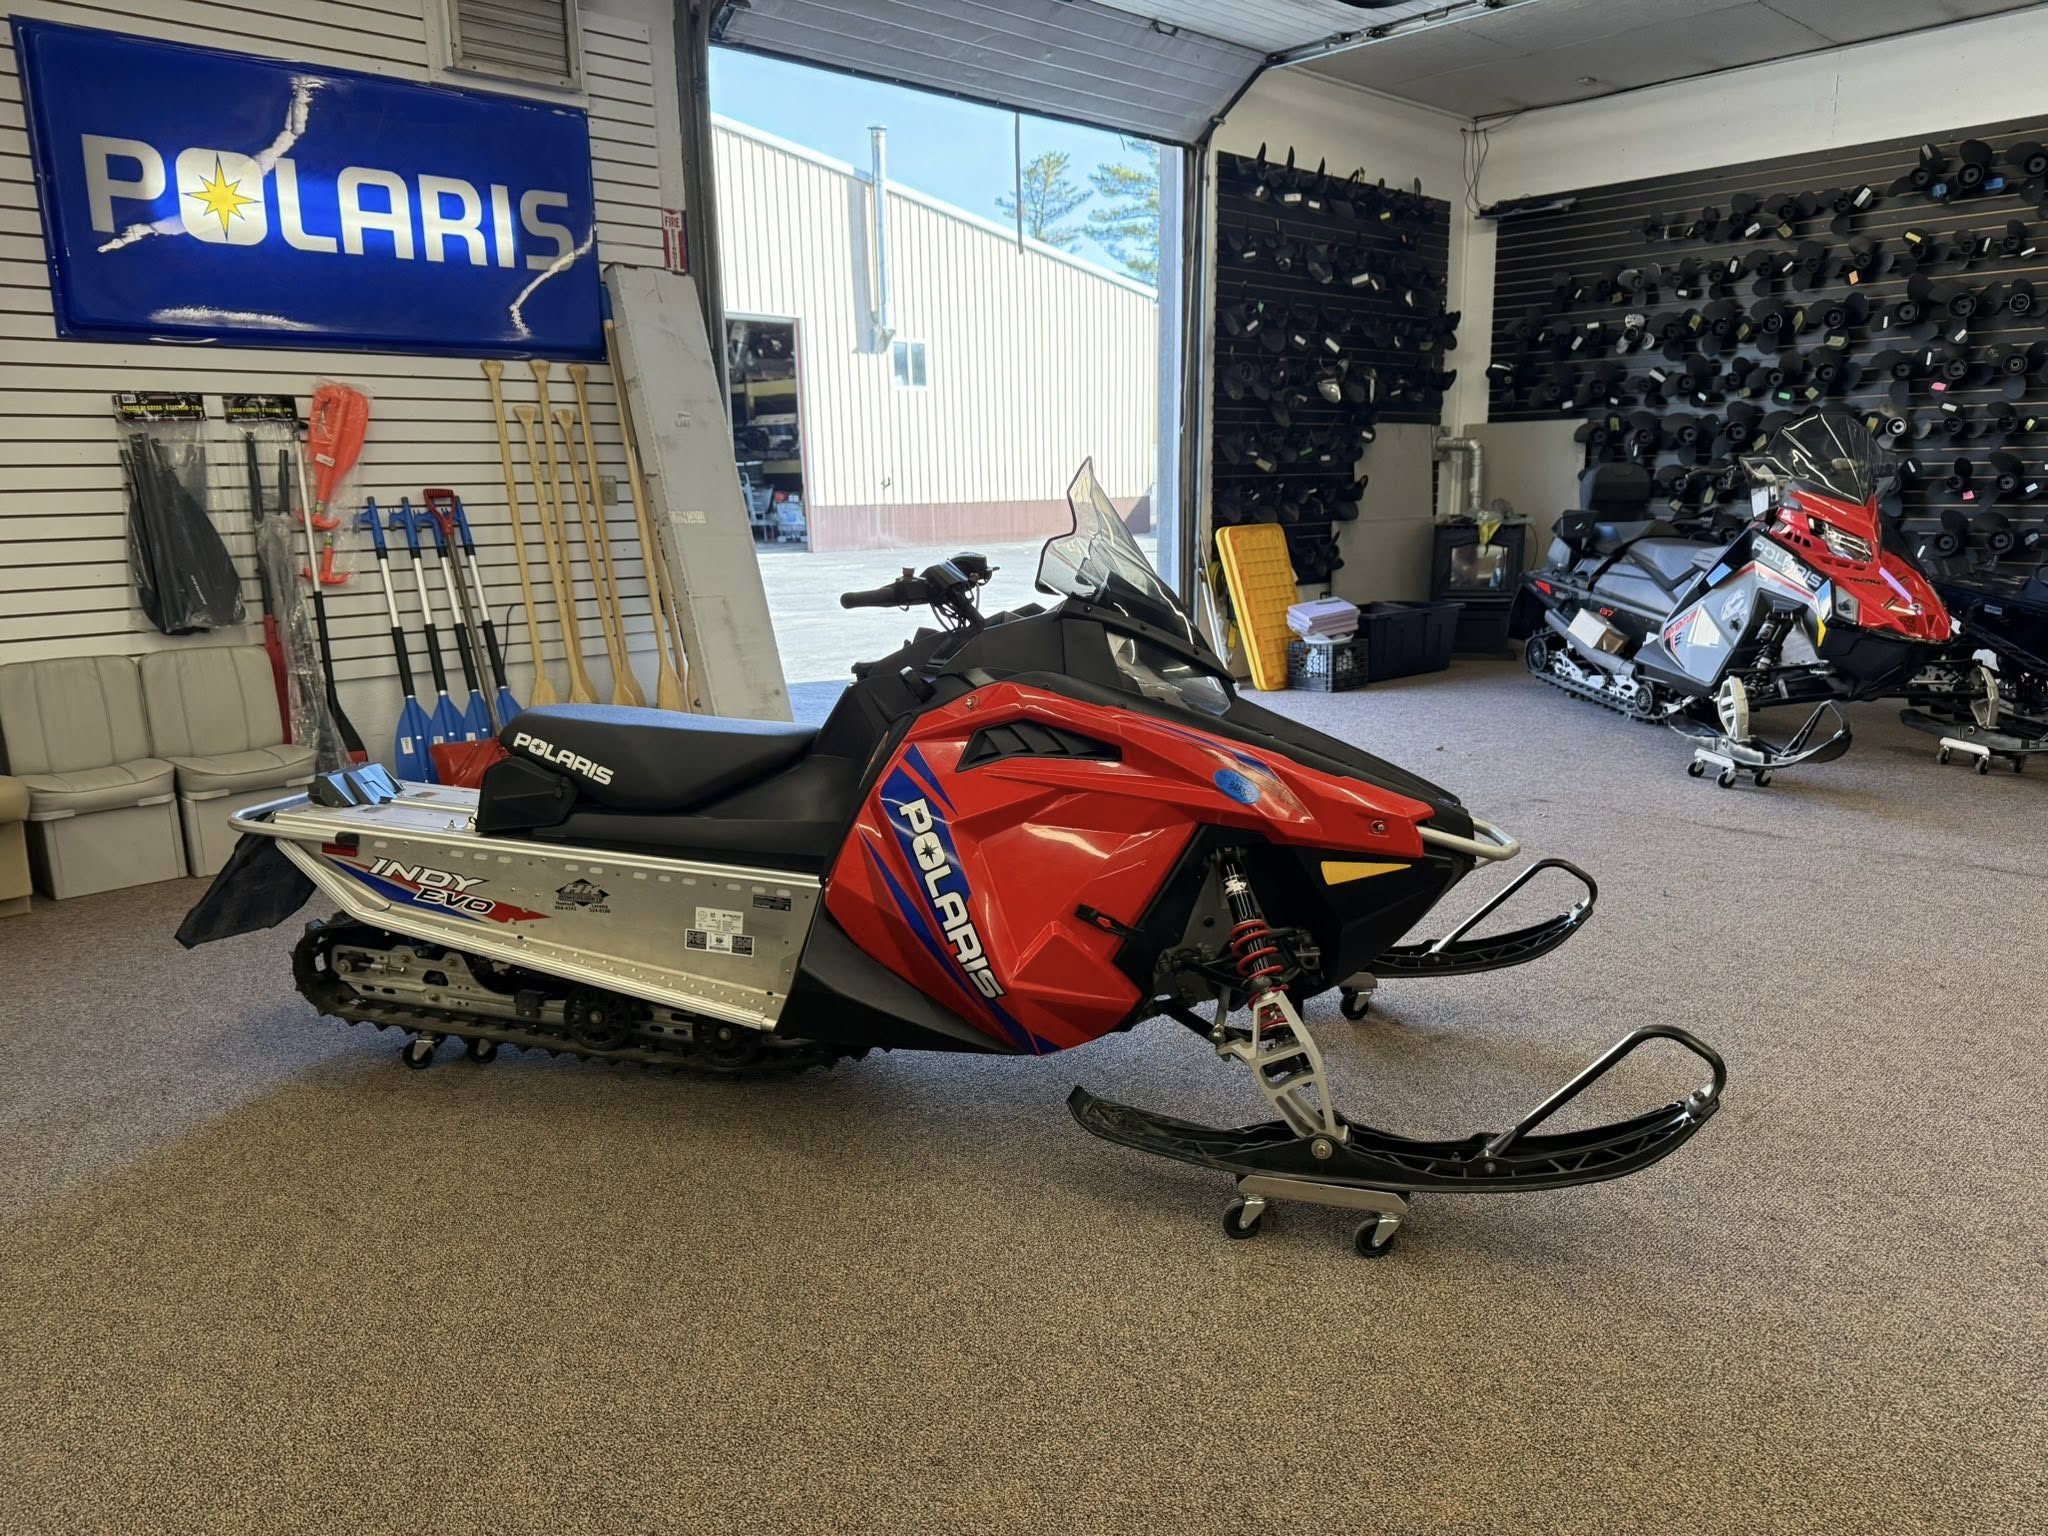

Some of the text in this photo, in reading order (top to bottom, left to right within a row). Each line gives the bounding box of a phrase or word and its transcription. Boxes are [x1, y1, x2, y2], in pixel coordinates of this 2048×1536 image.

[81, 133, 575, 272] POLARIS
[513, 732, 615, 785] POLARIS
[368, 856, 490, 892] INDY
[413, 885, 496, 915] EVO
[899, 798, 1006, 999] POLARIS
